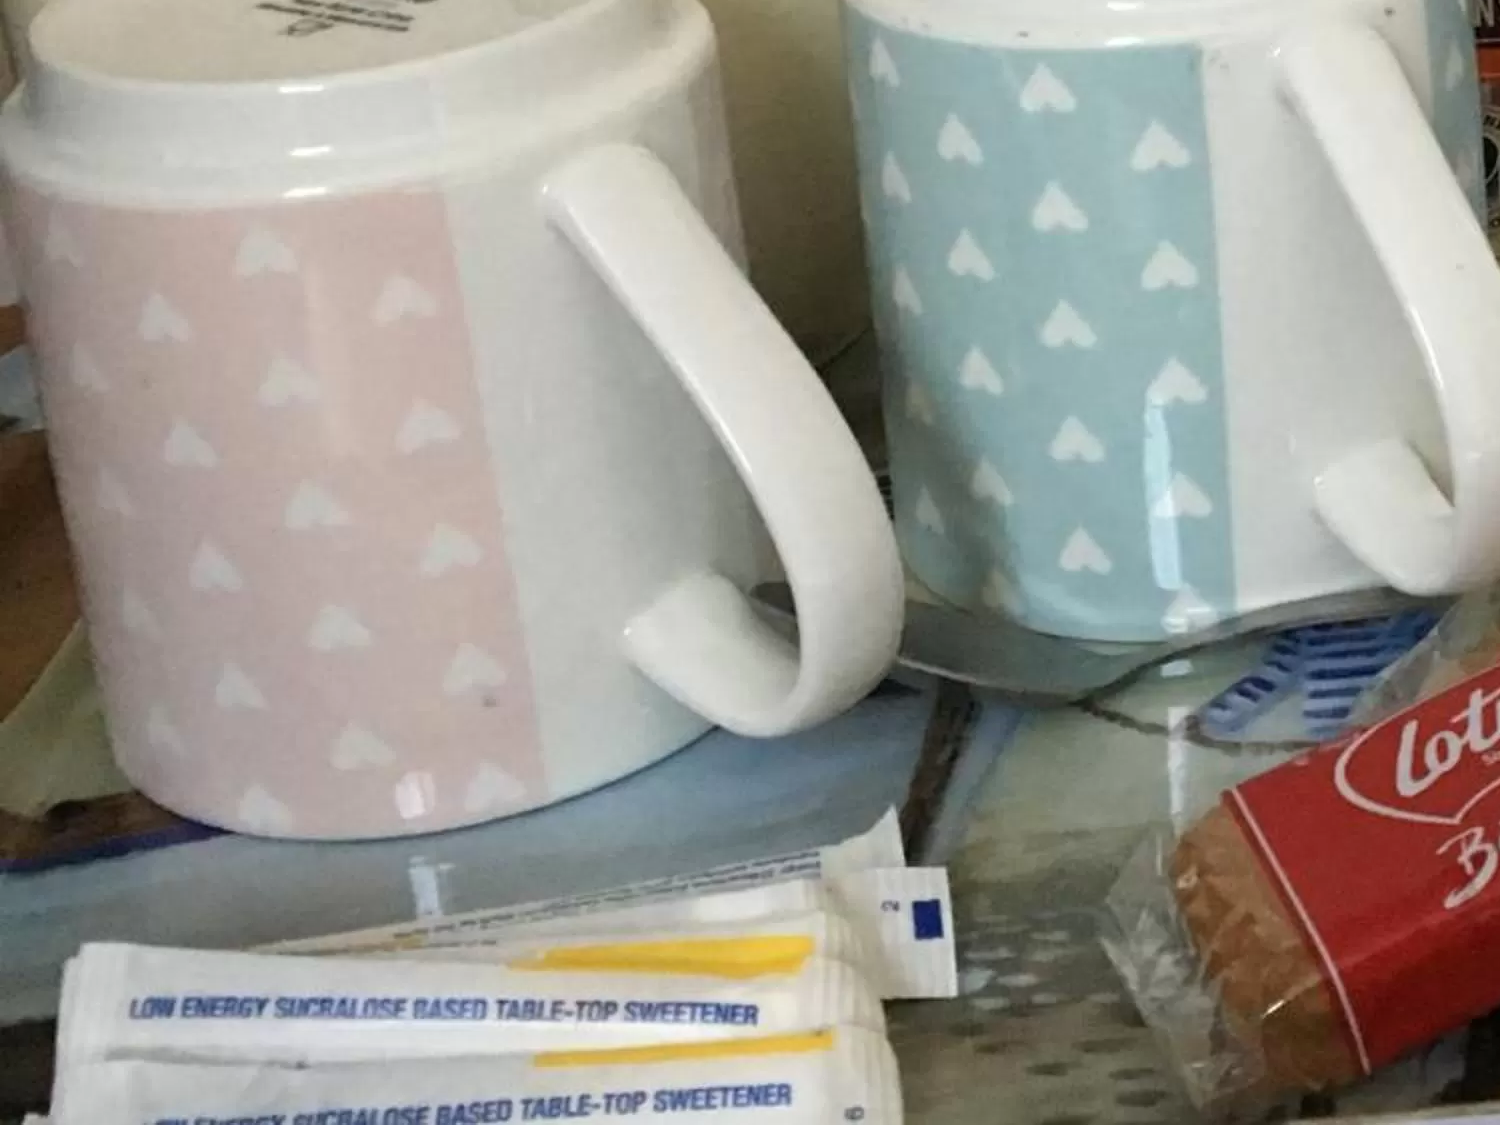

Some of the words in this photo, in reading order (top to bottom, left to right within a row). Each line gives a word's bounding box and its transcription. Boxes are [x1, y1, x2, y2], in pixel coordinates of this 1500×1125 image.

[128, 996, 177, 1020] LOW
[180, 996, 270, 1019] ENERGY
[272, 996, 411, 1020] SUCRALOSE
[412, 997, 489, 1021] BASED
[495, 998, 619, 1023] TABLE-TOP
[623, 1001, 760, 1026] SWEETENER
[434, 1098, 514, 1125] BASED
[520, 1090, 648, 1120] TABLE-TOP
[652, 1082, 794, 1114] SWEETENER
